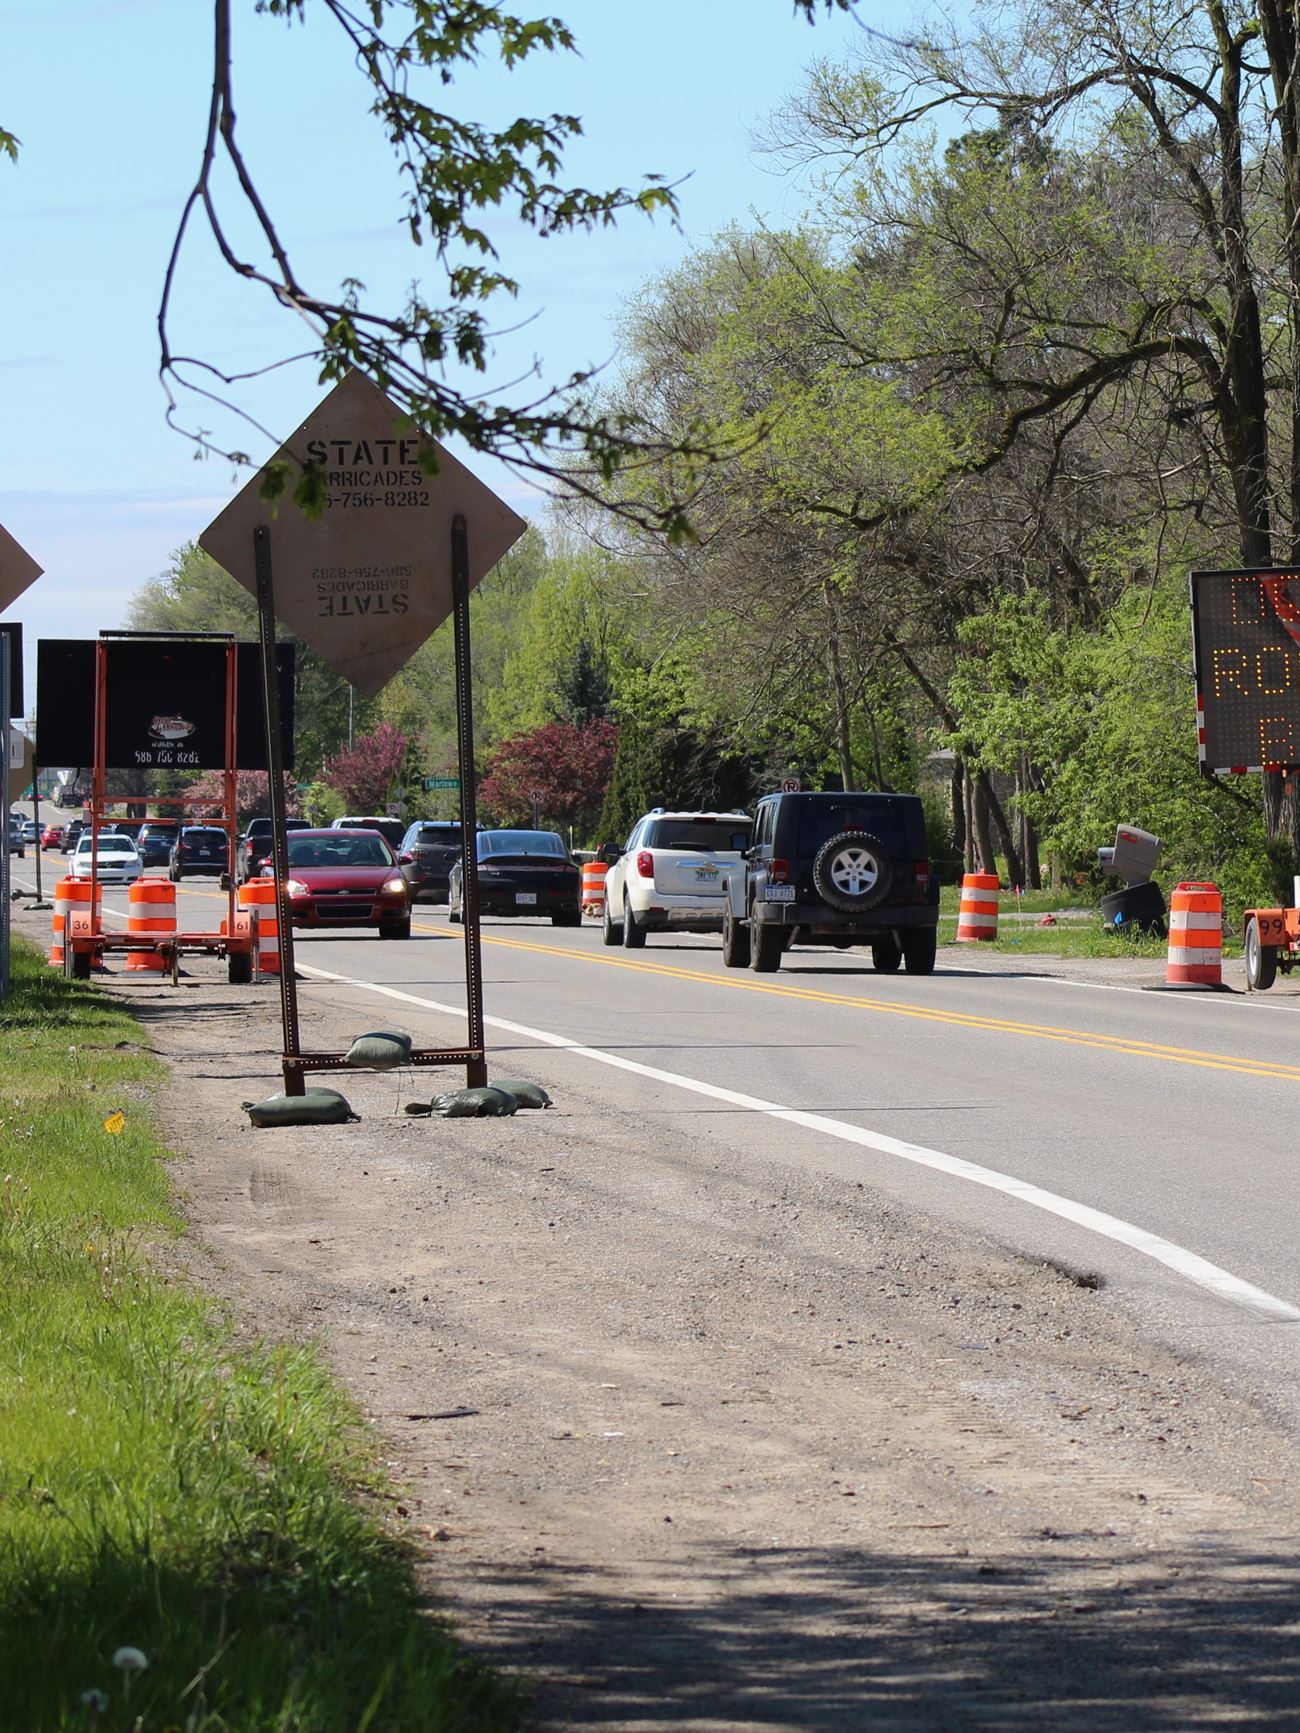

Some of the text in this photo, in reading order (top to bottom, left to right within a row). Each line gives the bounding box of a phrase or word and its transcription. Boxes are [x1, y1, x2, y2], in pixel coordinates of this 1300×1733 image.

[307, 440, 418, 465] STATE
[324, 470, 423, 486] RRICADES
[322, 490, 430, 508] 6-756-8282
[317, 580, 408, 592] BARRICADES
[318, 594, 408, 616] STATE
[74, 920, 89, 930] 36
[233, 921, 249, 931] 61
[1259, 918, 1283, 936] 99
